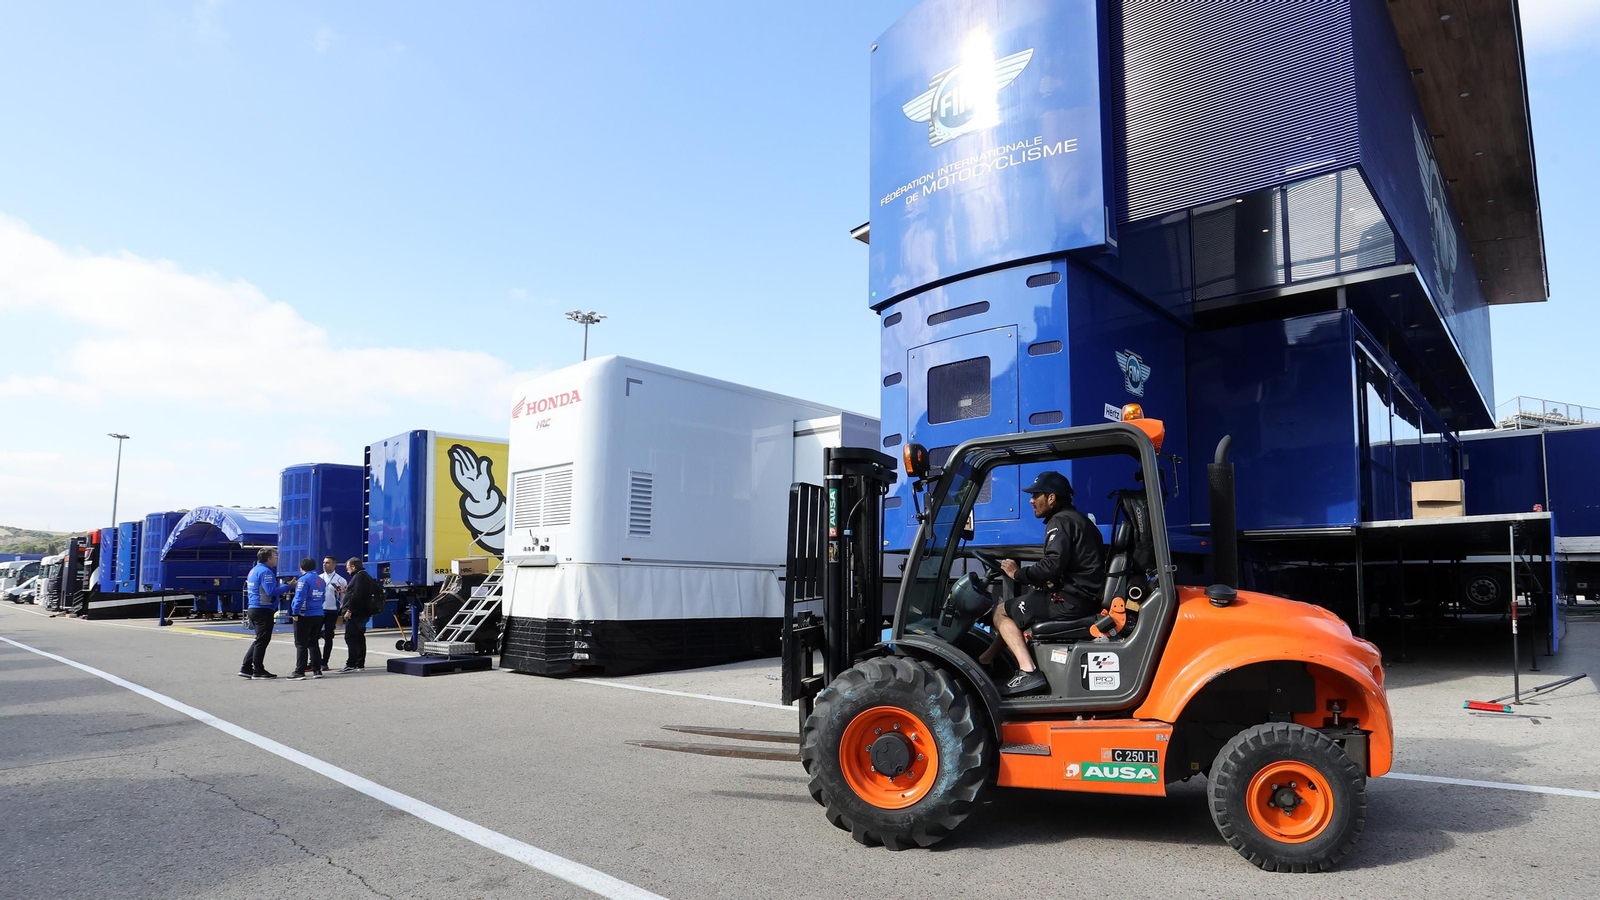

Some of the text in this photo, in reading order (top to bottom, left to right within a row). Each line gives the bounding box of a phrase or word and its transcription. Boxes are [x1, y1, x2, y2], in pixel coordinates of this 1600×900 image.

[880, 135, 1043, 207] FÉDÉRATION INTERNATIONALE
[905, 138, 1078, 205] DE MOTOCYCLISME
[525, 389, 582, 416] HONDA
[1106, 406, 1120, 420] Hertz
[1080, 664, 1088, 679] 7
[1114, 750, 1155, 762] C 250 H
[1083, 766, 1157, 780] AUSA
